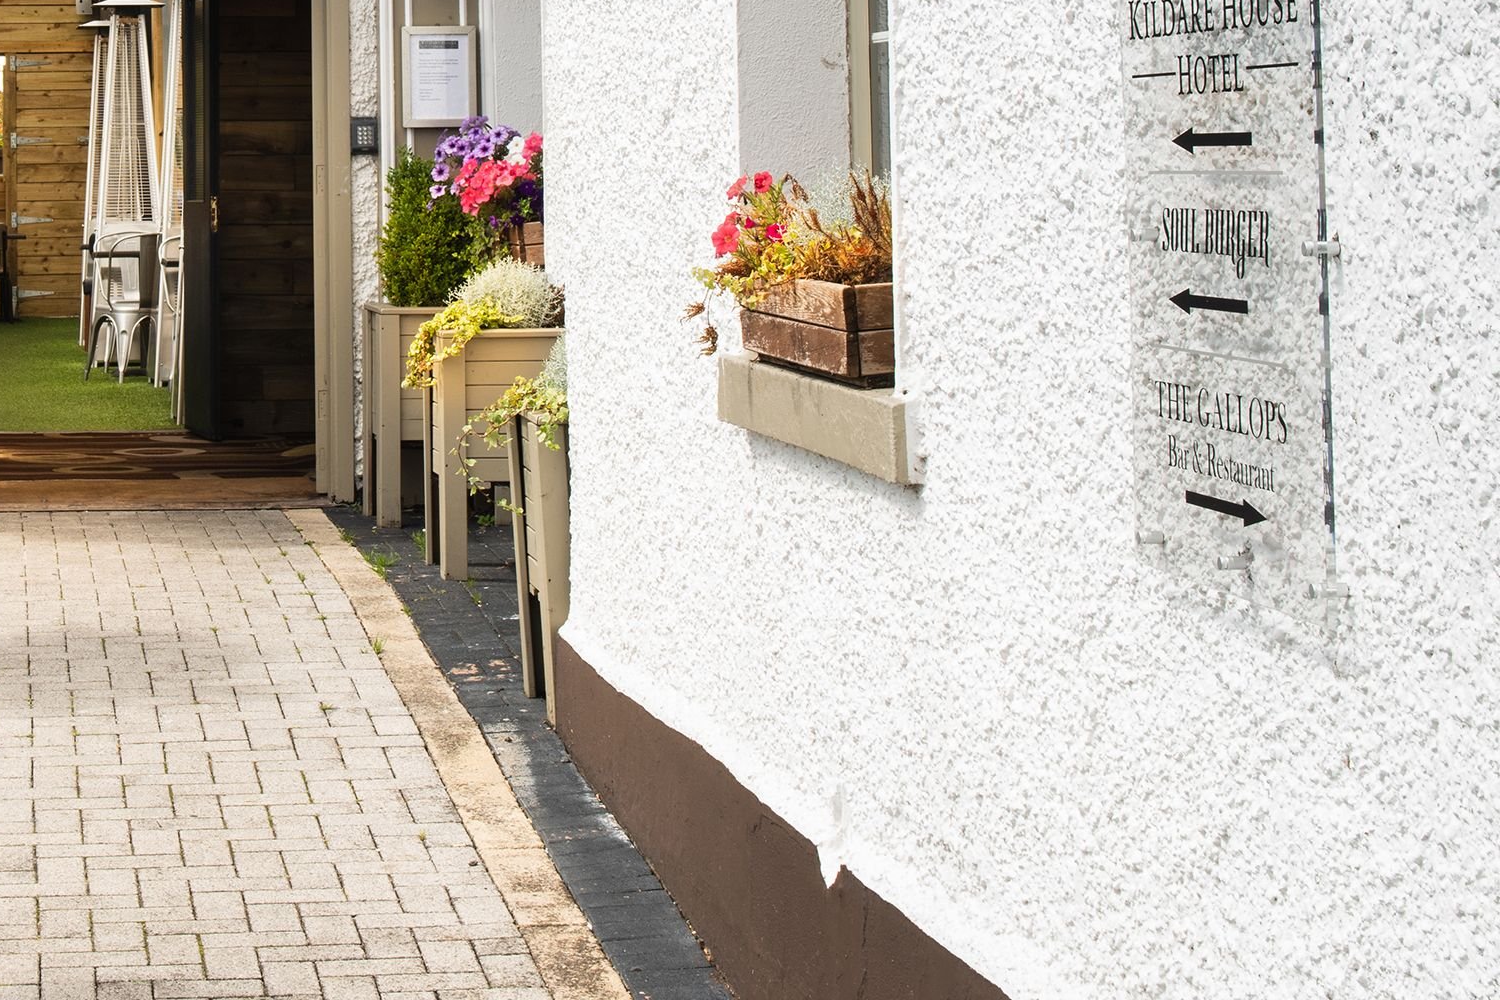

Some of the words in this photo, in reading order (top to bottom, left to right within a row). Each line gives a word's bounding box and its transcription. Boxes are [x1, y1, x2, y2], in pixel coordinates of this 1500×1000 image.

[1177, 53, 1244, 96] HOTEL
[1161, 207, 1200, 254] SOUL
[1203, 209, 1270, 280] BURGER
[1154, 380, 1193, 424] THE
[1197, 387, 1288, 445] GALLOPS
[1168, 434, 1189, 470] Bar
[1192, 439, 1203, 475] &
[1206, 442, 1276, 493] Restaurant
